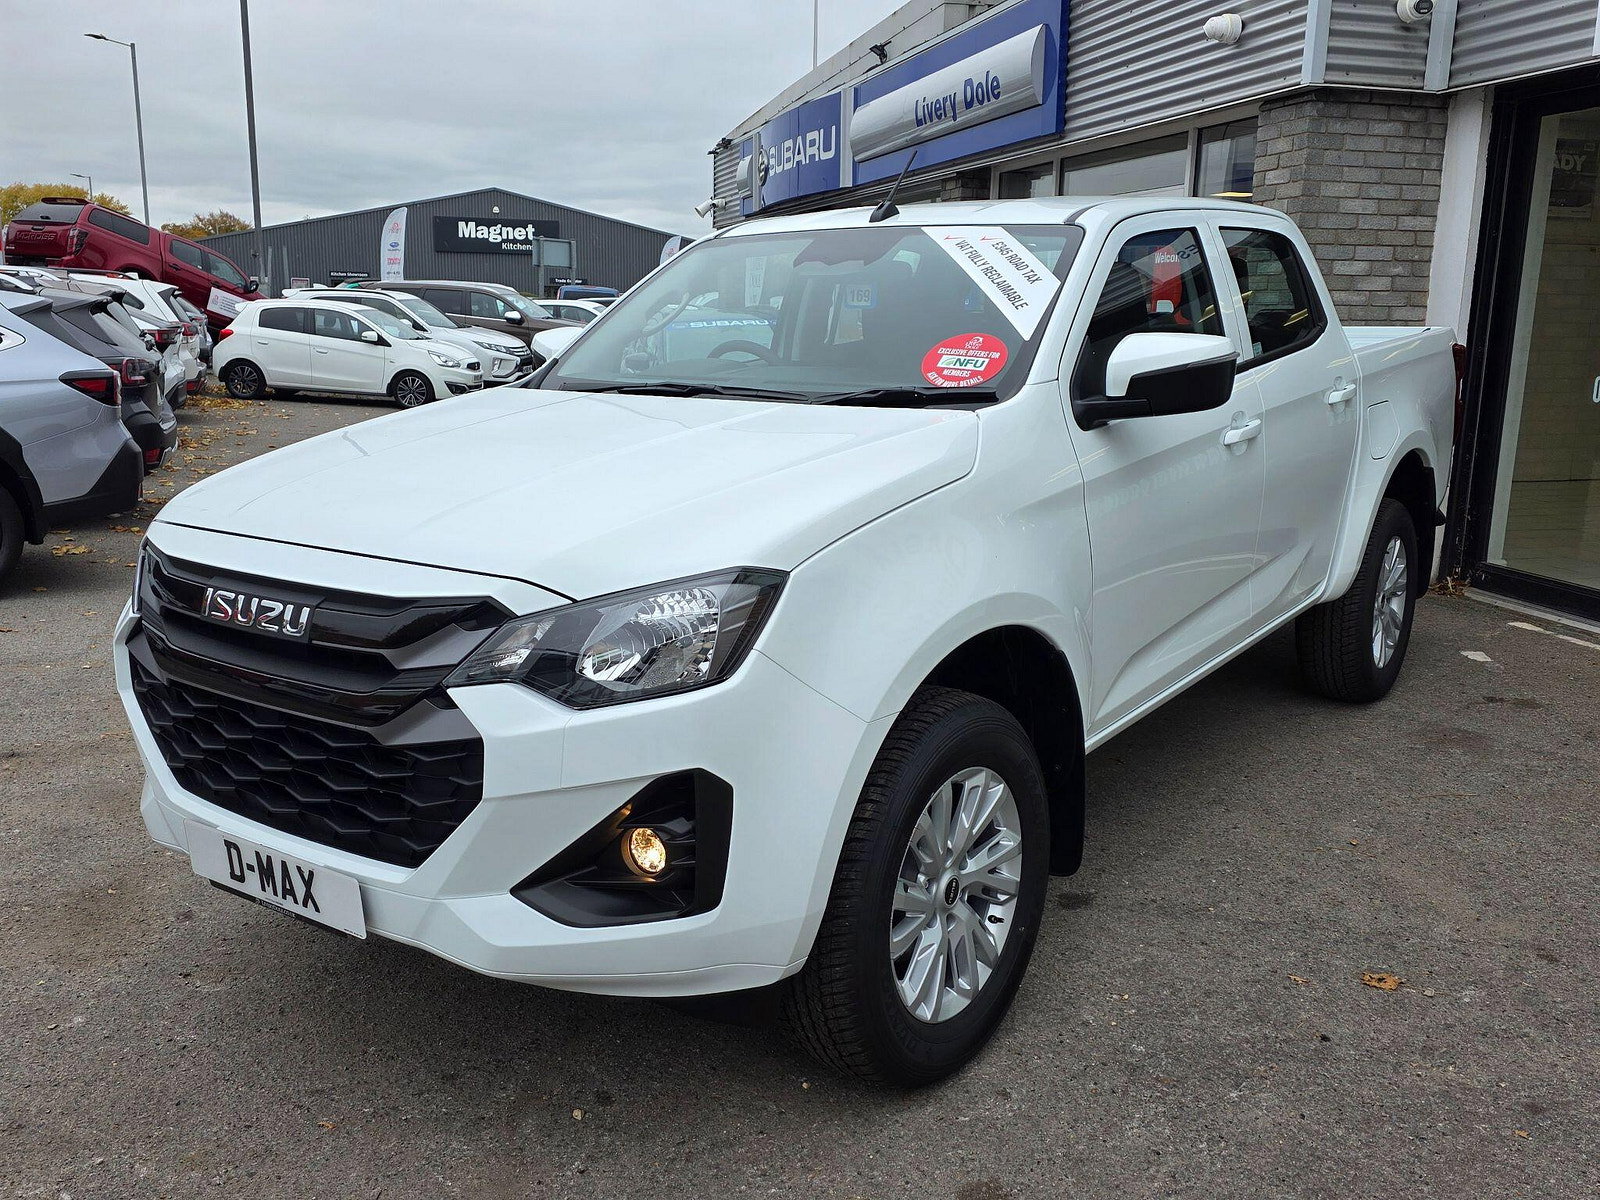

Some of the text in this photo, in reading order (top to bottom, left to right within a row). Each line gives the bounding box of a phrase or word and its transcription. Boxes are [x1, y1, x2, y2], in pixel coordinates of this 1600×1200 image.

[915, 71, 1001, 127] Livery Dole
[769, 125, 836, 177] SUBARU
[1553, 153, 1587, 172] ADY
[458, 221, 535, 242] Magnet
[991, 241, 1043, 285] £345 ROAD TAX
[955, 239, 1029, 310] VAT FULLY RECLAIMABLE
[689, 318, 770, 328] SUBARU
[938, 348, 1000, 359] EXCLUSIVE OFFERS FOR
[953, 358, 985, 369] NFU
[943, 369, 971, 378] MEMBERS
[960, 375, 984, 386] DETAILS
[201, 587, 310, 637] ISUZU
[223, 838, 321, 913] D-MAX
